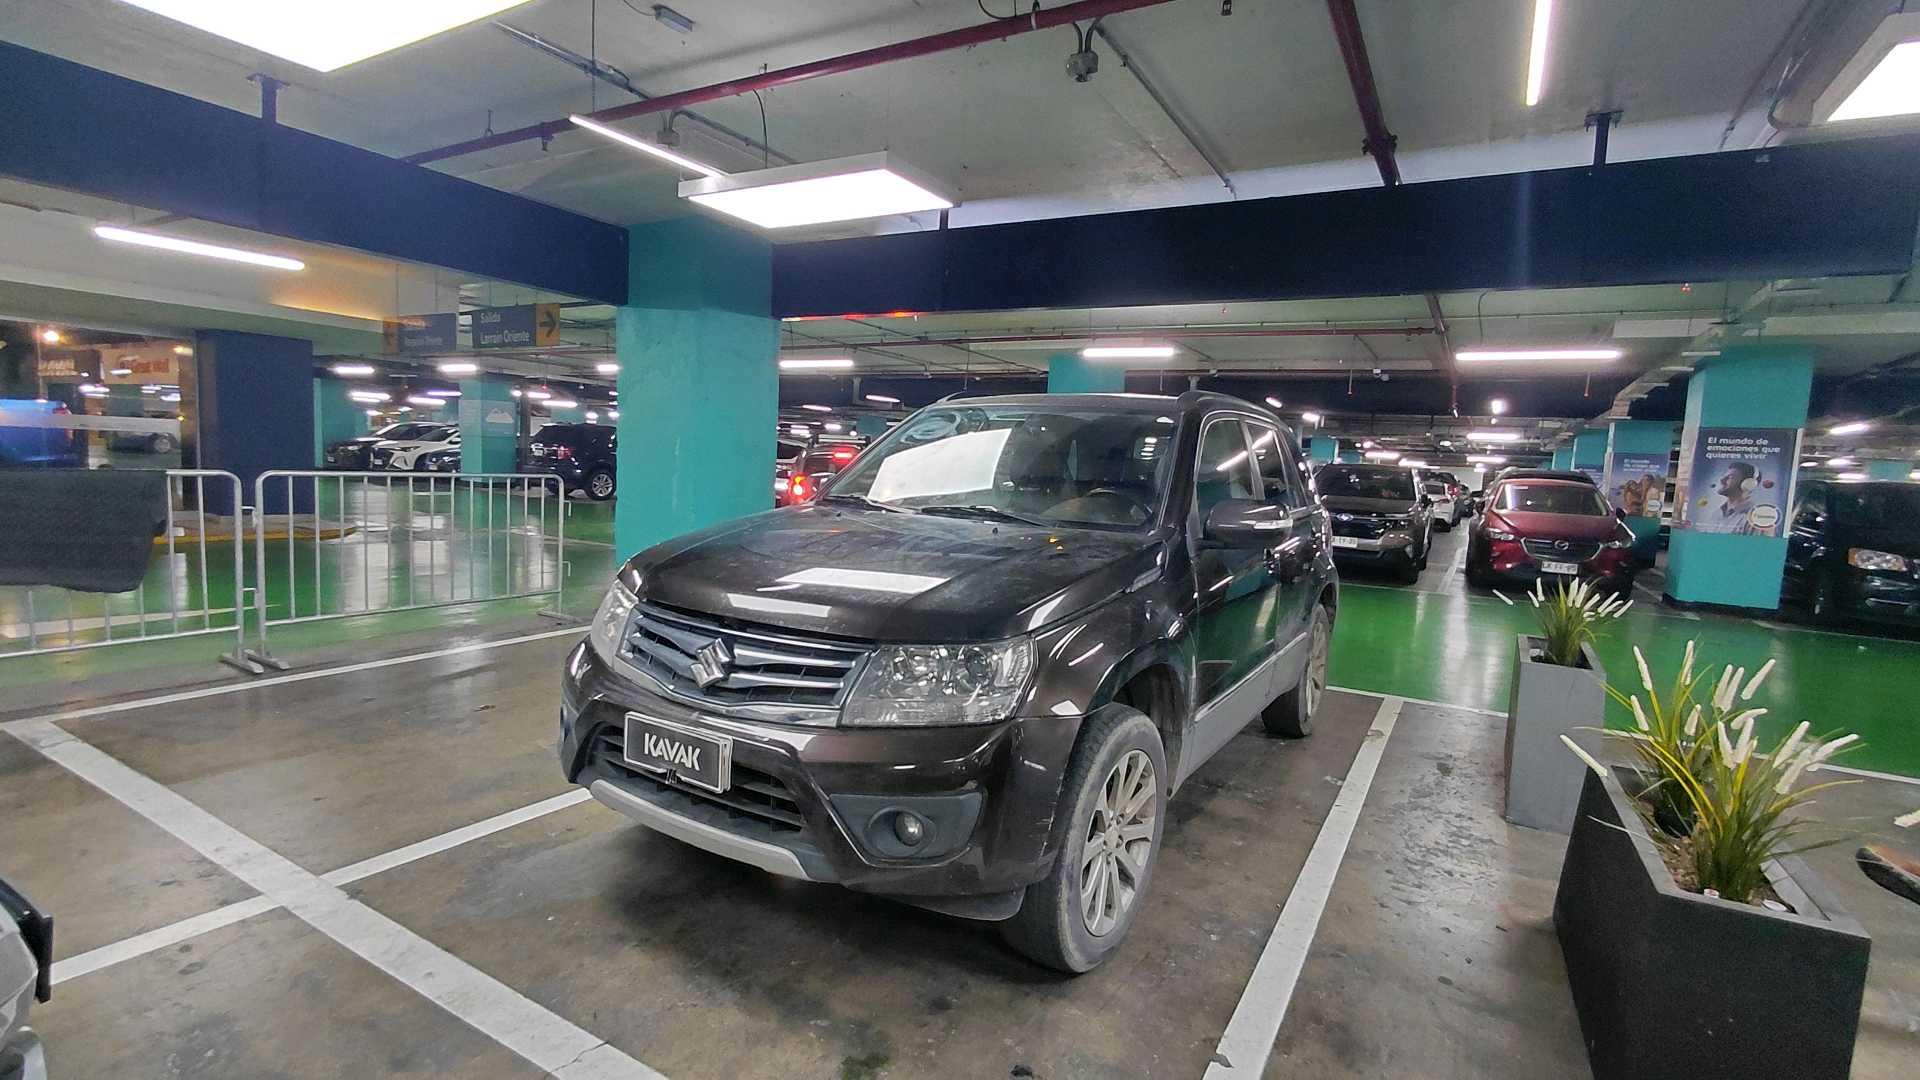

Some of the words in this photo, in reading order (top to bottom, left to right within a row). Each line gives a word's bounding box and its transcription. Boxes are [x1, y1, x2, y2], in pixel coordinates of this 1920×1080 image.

[480, 311, 502, 323] Salida
[503, 329, 530, 343] Oriente
[1707, 436, 1717, 444] El
[1719, 437, 1754, 445] mundo
[1761, 446, 1781, 454] que
[643, 732, 701, 771] KAVAK
